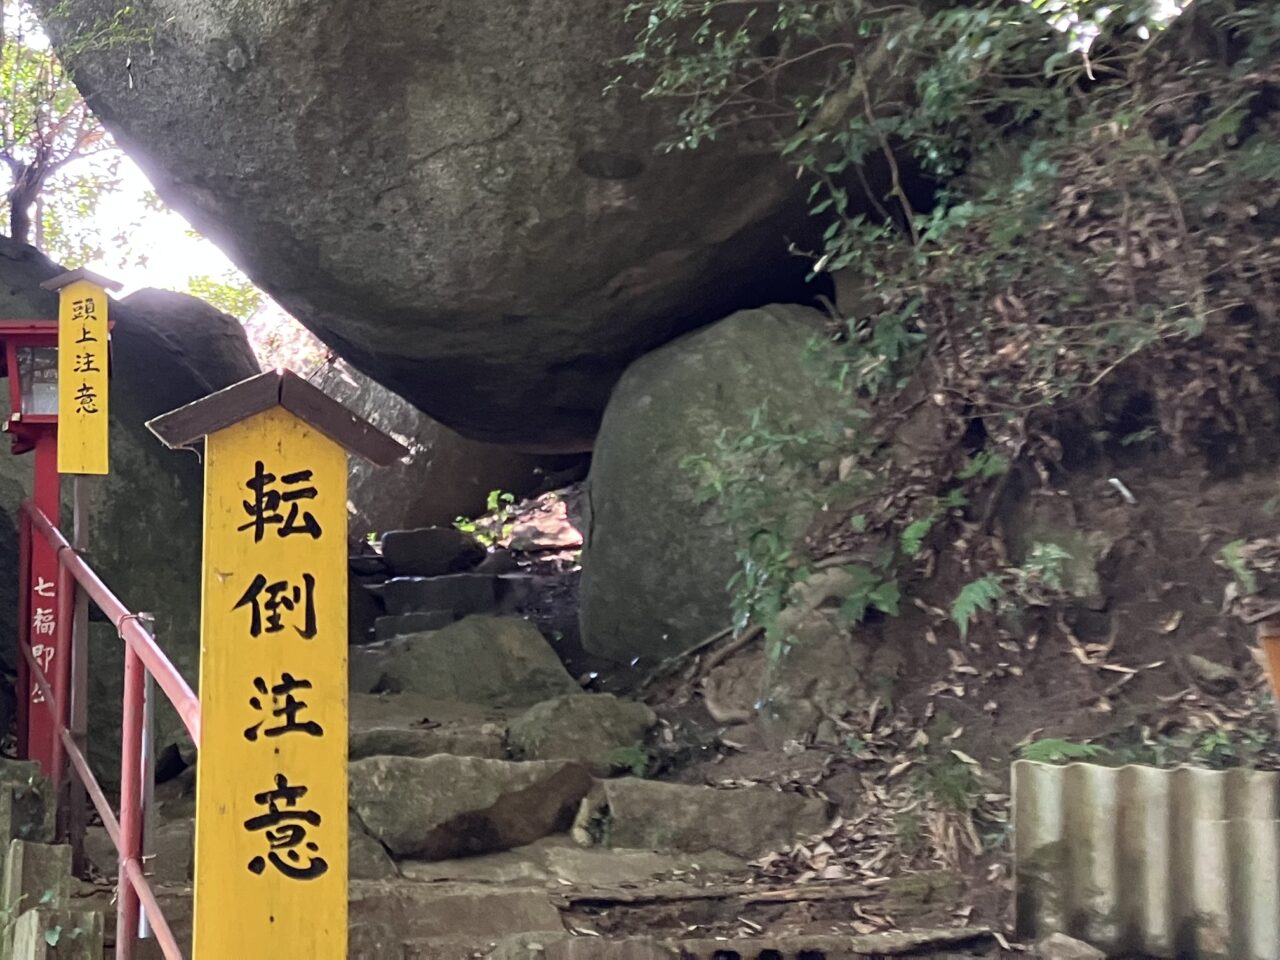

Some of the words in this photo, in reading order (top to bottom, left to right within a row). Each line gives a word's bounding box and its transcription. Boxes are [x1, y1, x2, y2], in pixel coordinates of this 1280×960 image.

[72, 298, 100, 414] 頭上注意
[231, 460, 329, 881] 転倒注意
